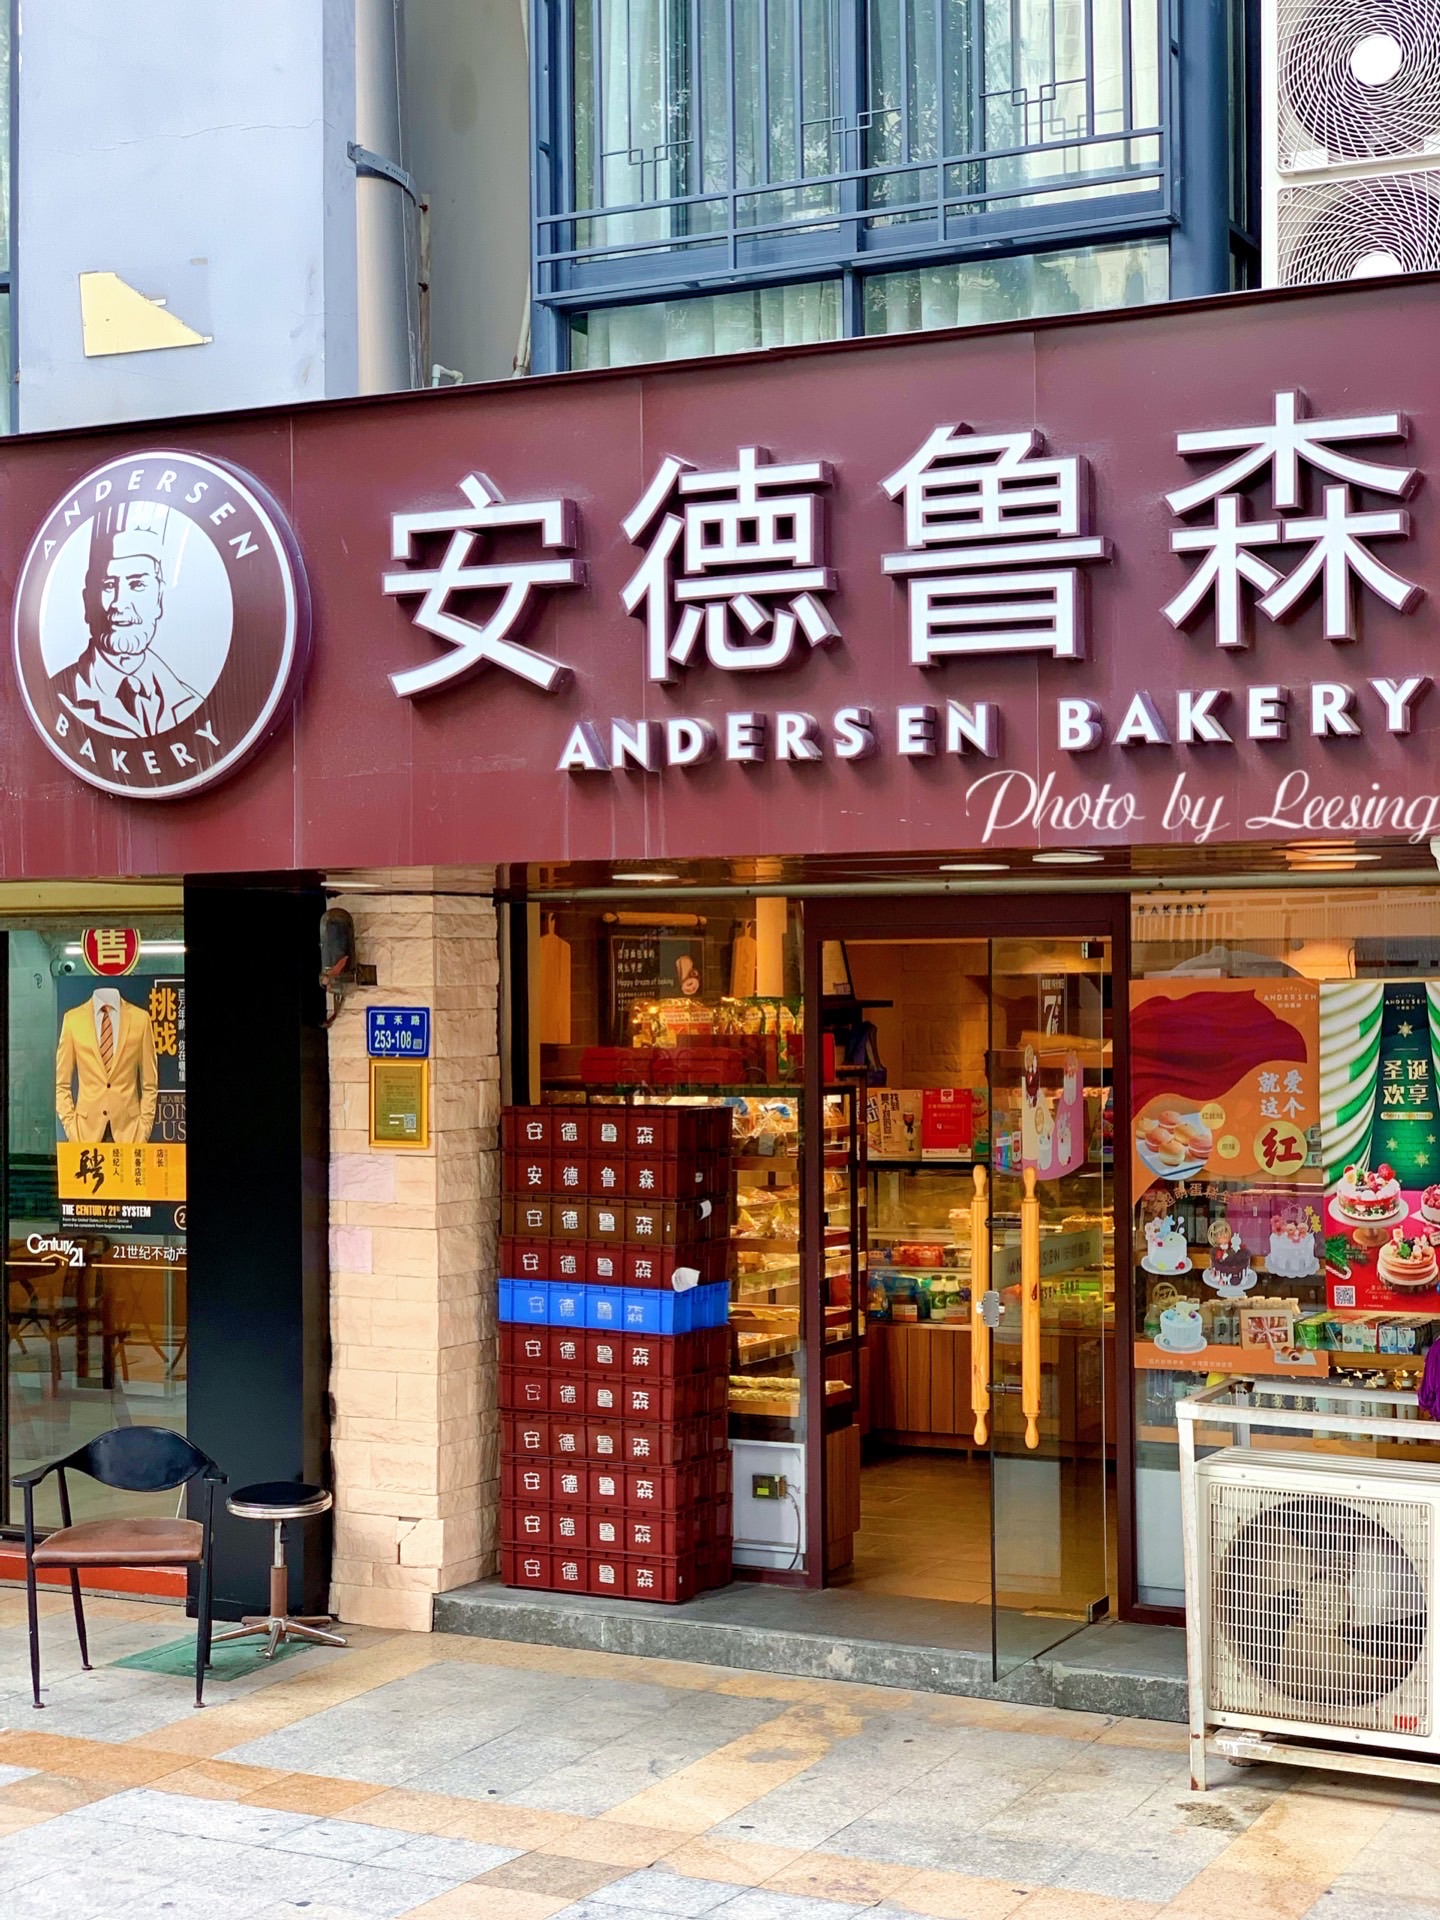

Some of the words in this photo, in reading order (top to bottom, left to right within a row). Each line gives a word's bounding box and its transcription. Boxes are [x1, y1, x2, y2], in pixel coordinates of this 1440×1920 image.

[42, 468, 259, 561] ANDERSEN
[380, 389, 1420, 699] 安德鲁森
[556, 698, 998, 773] ANDERSEN
[1057, 676, 1430, 752] BAKERY
[56, 711, 222, 776] BAKERY
[94, 929, 128, 966] 售
[148, 987, 177, 1056] 挑战
[374, 1030, 412, 1049] 253-108
[1257, 1069, 1304, 1094] 就爱
[1382, 1059, 1430, 1081] 圣诞
[1382, 1084, 1430, 1105] 欢享
[1260, 1096, 1306, 1119] 这个
[161, 1120, 187, 1142] US
[526, 1121, 654, 1145] 安德鲁森
[156, 1149, 164, 1168] 店长
[1261, 1127, 1303, 1169] 红
[74, 1147, 105, 1195] 聘
[112, 1148, 120, 1177] 经纪人
[527, 1165, 655, 1190] 安德鲁森
[62, 1204, 75, 1216] THE
[75, 1204, 107, 1217] CENTURY
[121, 1205, 151, 1218] SYSTEM
[526, 1209, 653, 1236] 安德鲁森
[26, 1232, 75, 1255] Century
[112, 1245, 187, 1262] 21世纪不动产
